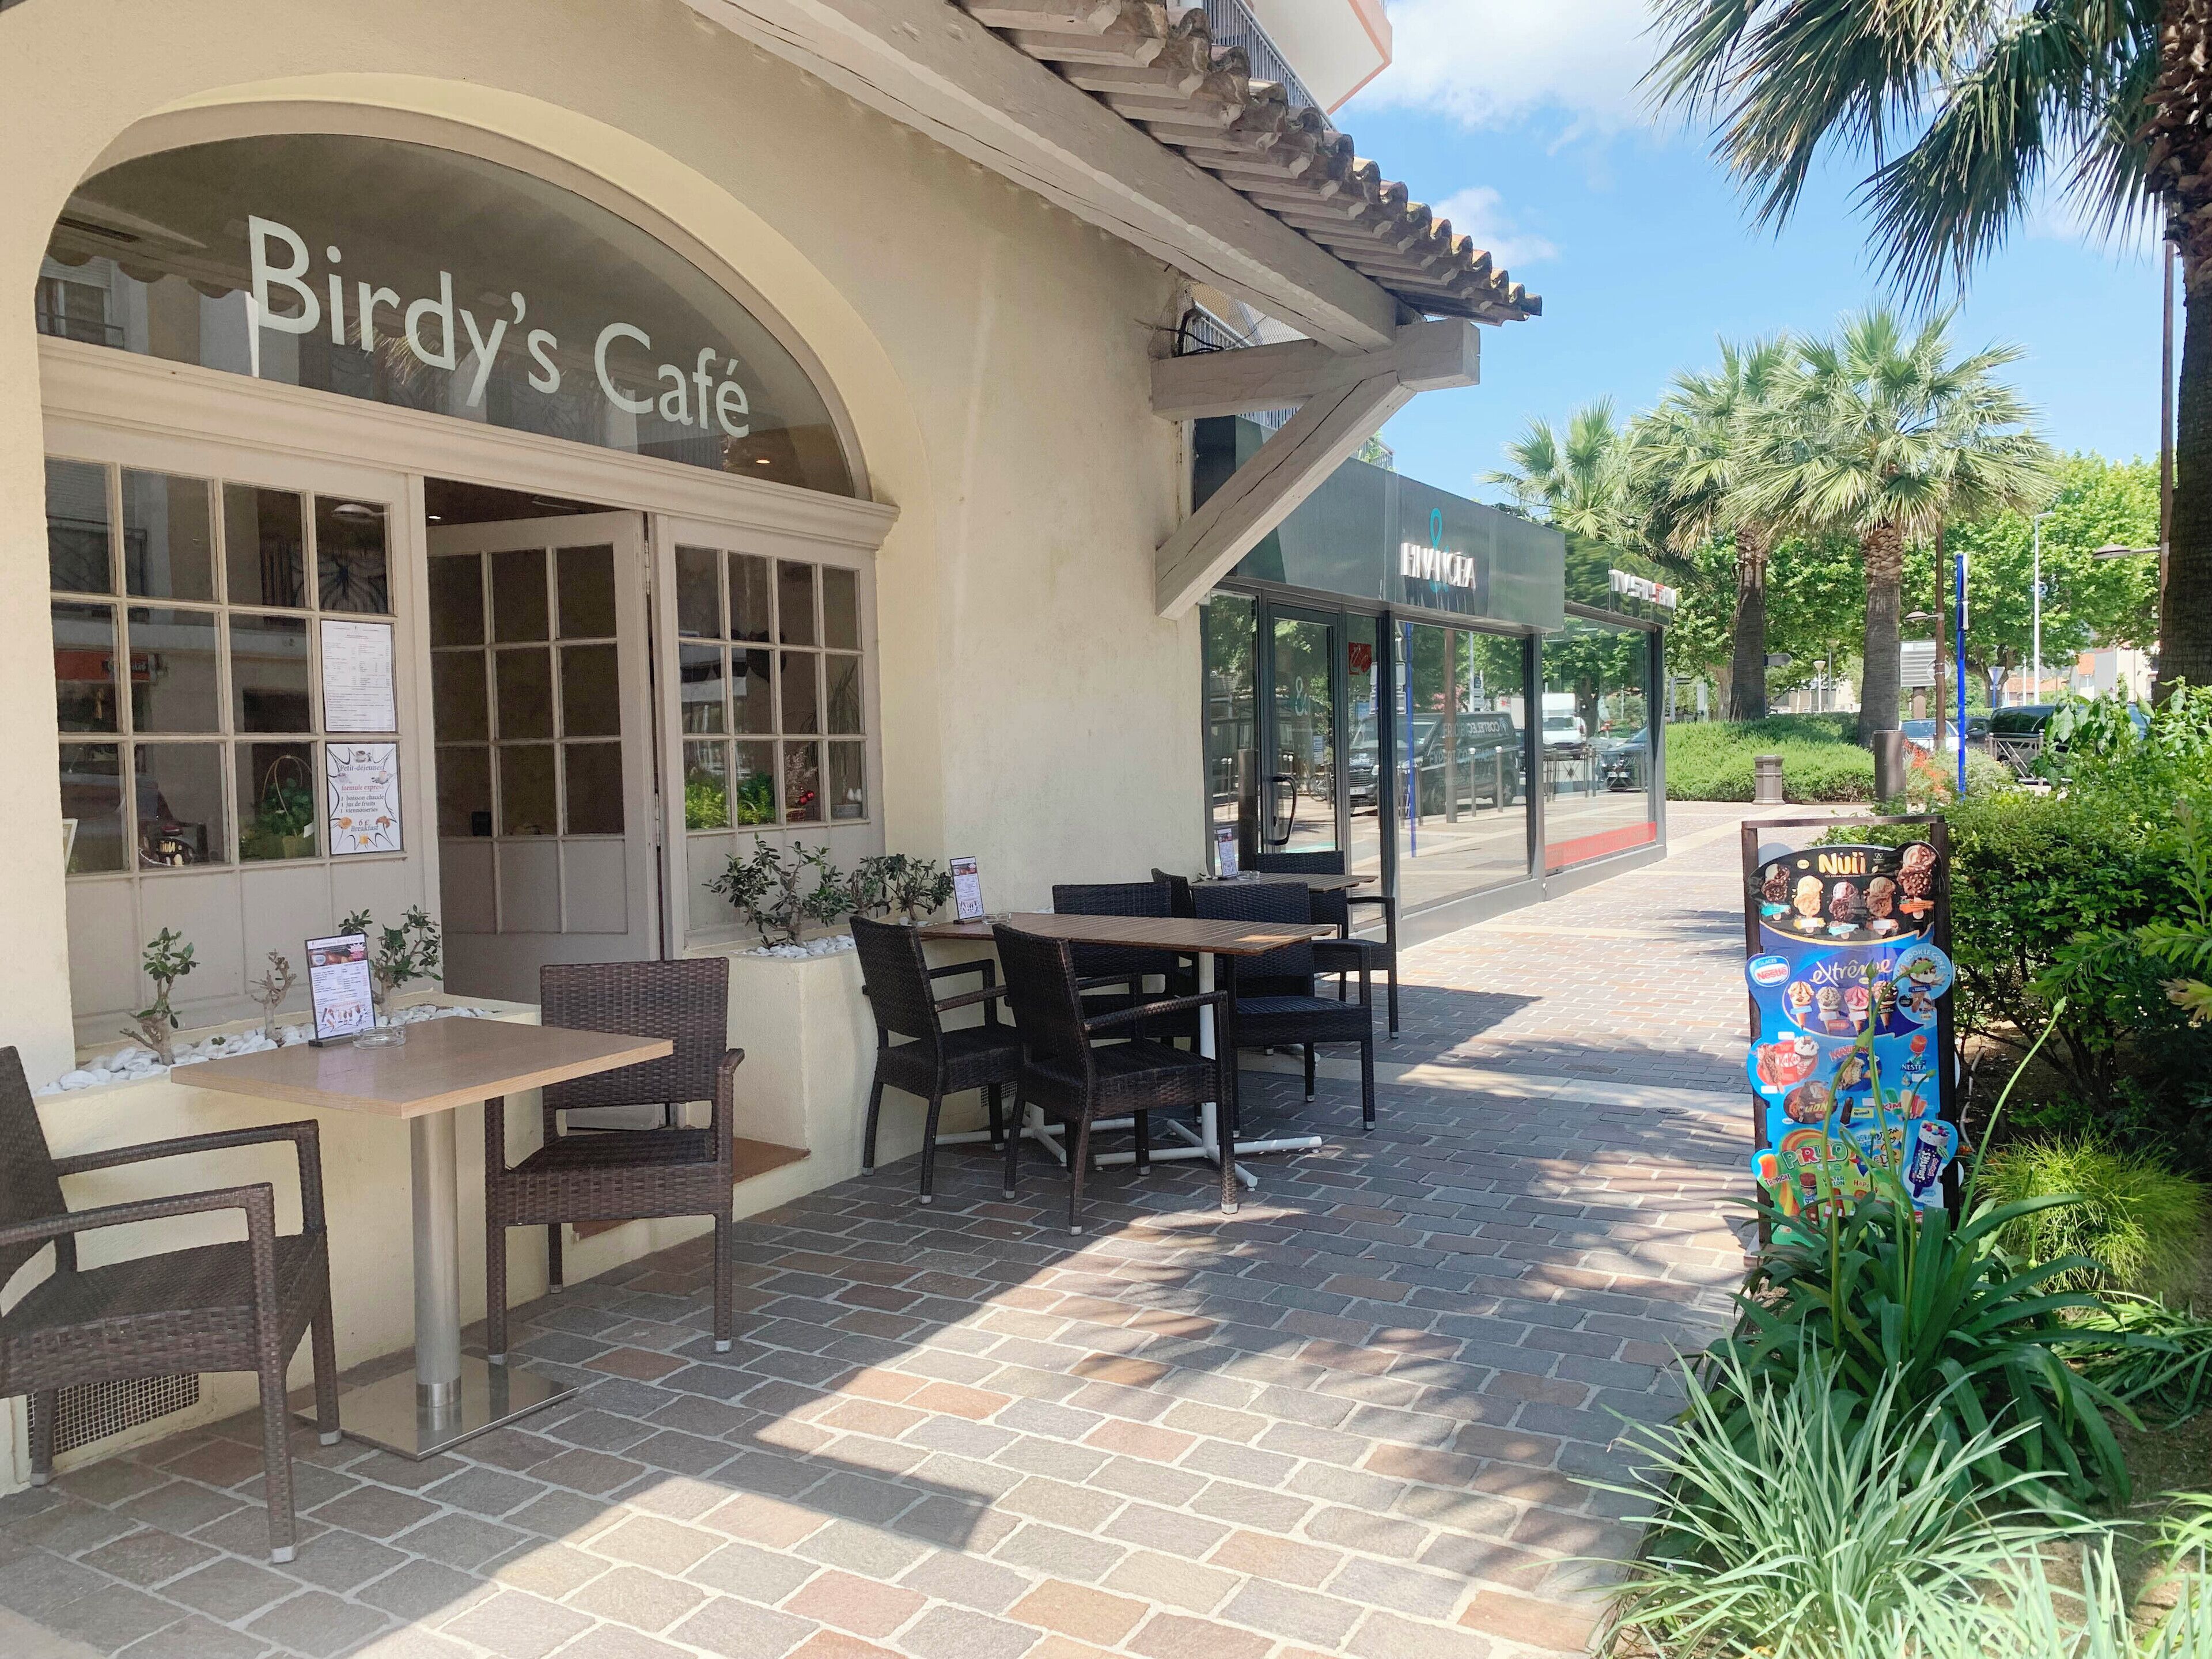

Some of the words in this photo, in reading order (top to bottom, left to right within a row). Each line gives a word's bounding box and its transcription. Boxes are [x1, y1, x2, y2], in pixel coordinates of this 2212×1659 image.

[247, 214, 561, 407] Birdy's
[594, 322, 749, 438] Café
[1818, 851, 1866, 875] Nuii
[1904, 949, 1931, 963] COOKIE
